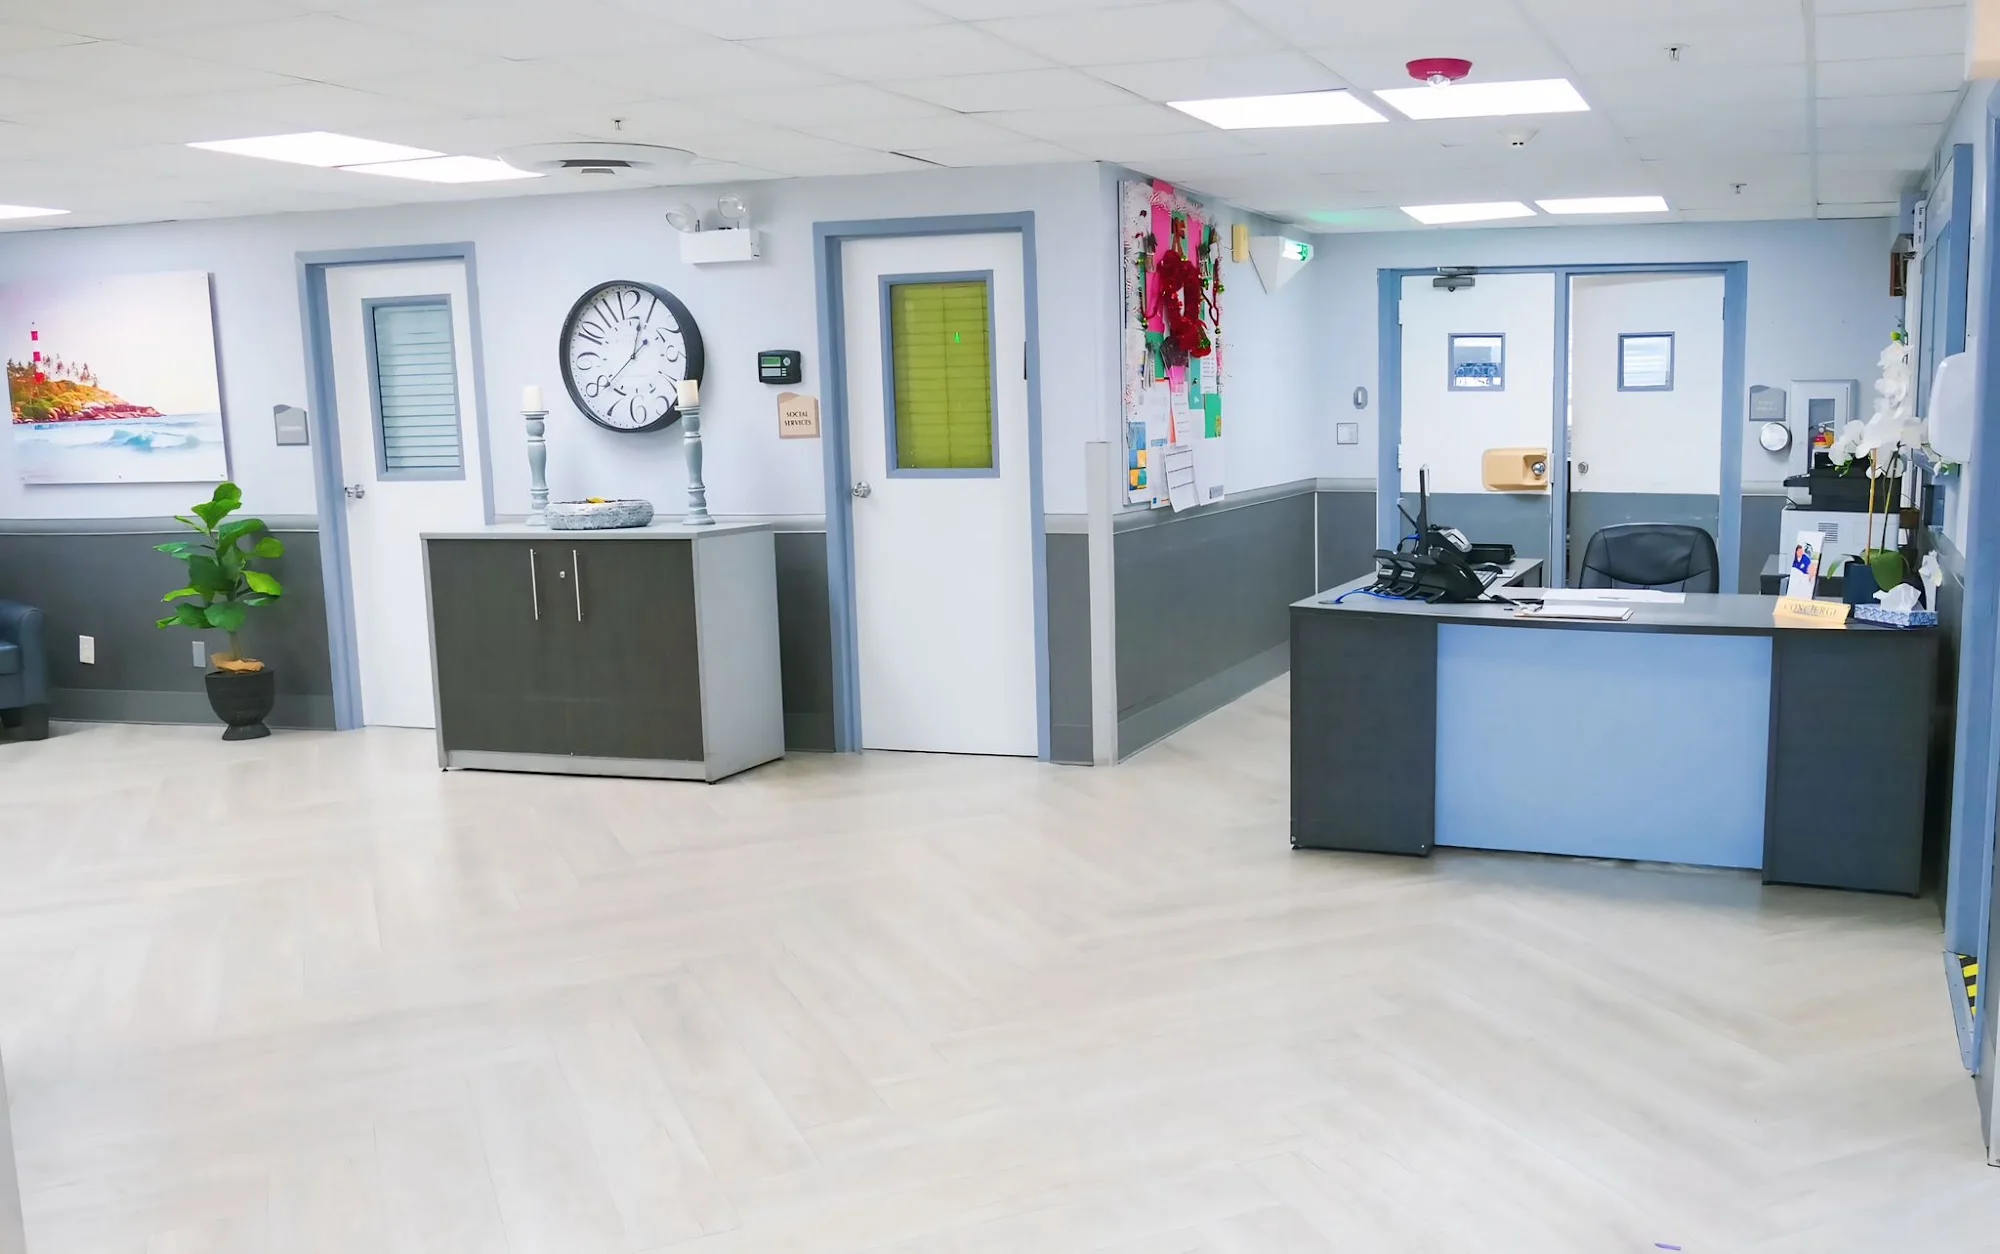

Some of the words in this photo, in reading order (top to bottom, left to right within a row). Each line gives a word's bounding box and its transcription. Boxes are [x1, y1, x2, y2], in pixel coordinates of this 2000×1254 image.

[593, 298, 619, 328] 11
[616, 290, 641, 321] 12
[645, 297, 658, 323] 1
[578, 321, 606, 346] 10
[655, 313, 681, 343] 2
[576, 351, 600, 371] 9
[665, 344, 686, 363] 3
[585, 374, 610, 398] 8
[607, 387, 627, 417] 7
[629, 394, 647, 423] 6
